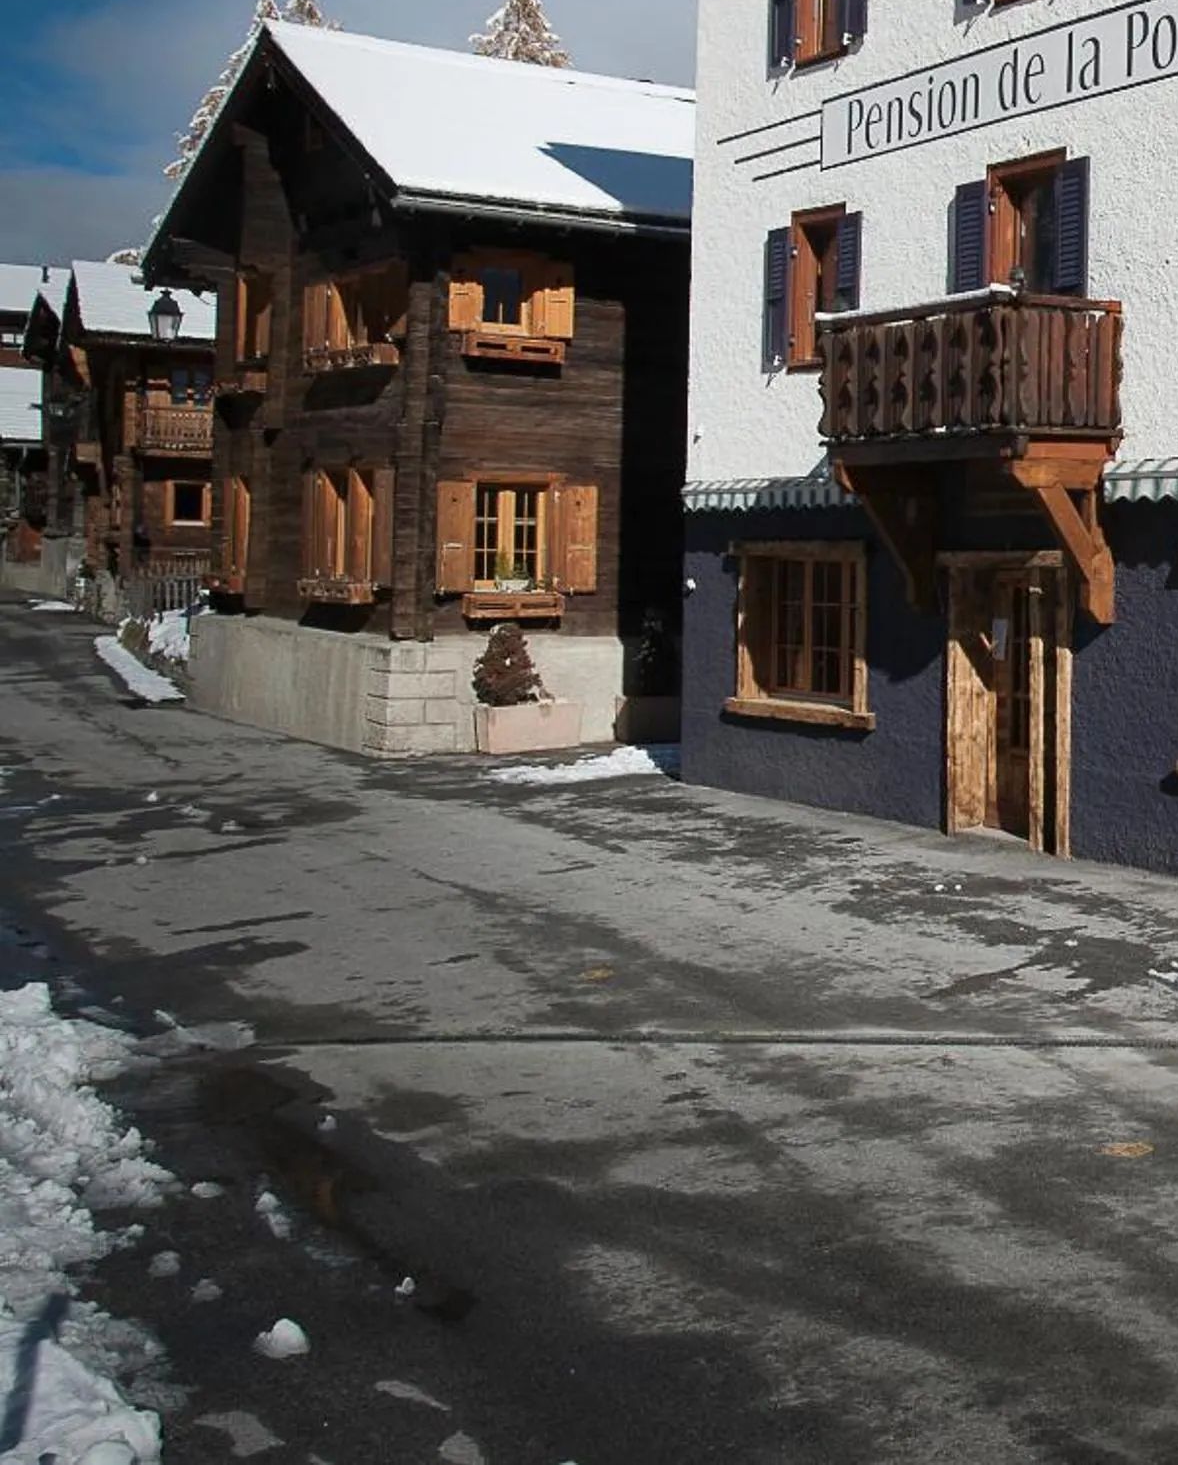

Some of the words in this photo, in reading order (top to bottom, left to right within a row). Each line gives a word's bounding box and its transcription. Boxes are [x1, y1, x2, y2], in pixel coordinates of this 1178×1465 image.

[847, 74, 980, 155] Pension
[998, 48, 1045, 112] de
[1066, 31, 1100, 93] la
